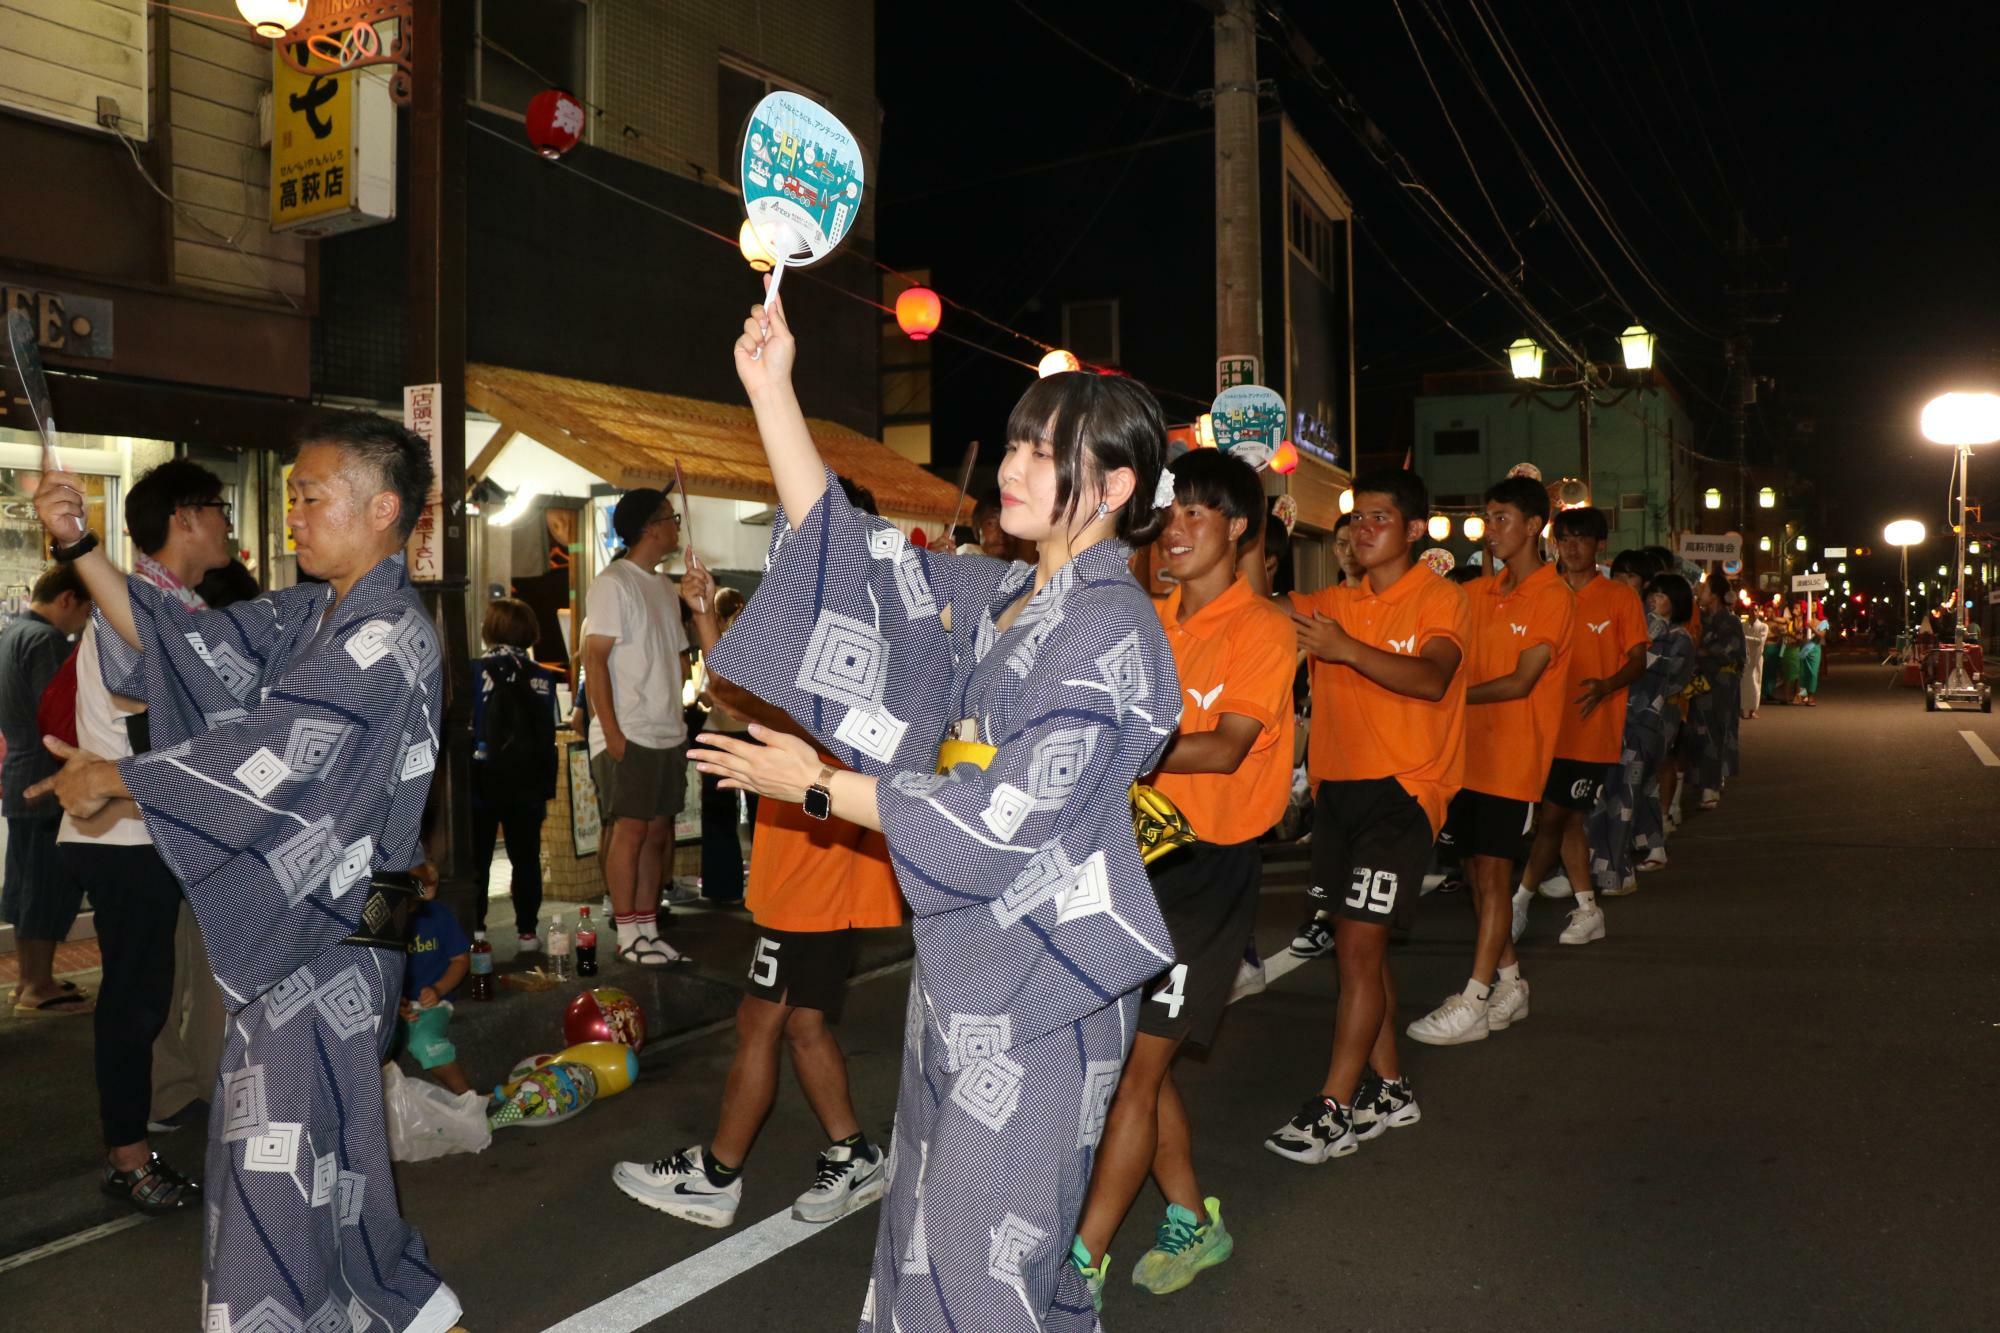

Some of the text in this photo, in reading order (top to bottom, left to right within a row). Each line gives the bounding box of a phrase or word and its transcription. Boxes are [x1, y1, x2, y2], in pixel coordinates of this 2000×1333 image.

[279, 165, 345, 212] 高萩店
[1344, 867, 1399, 915] 39
